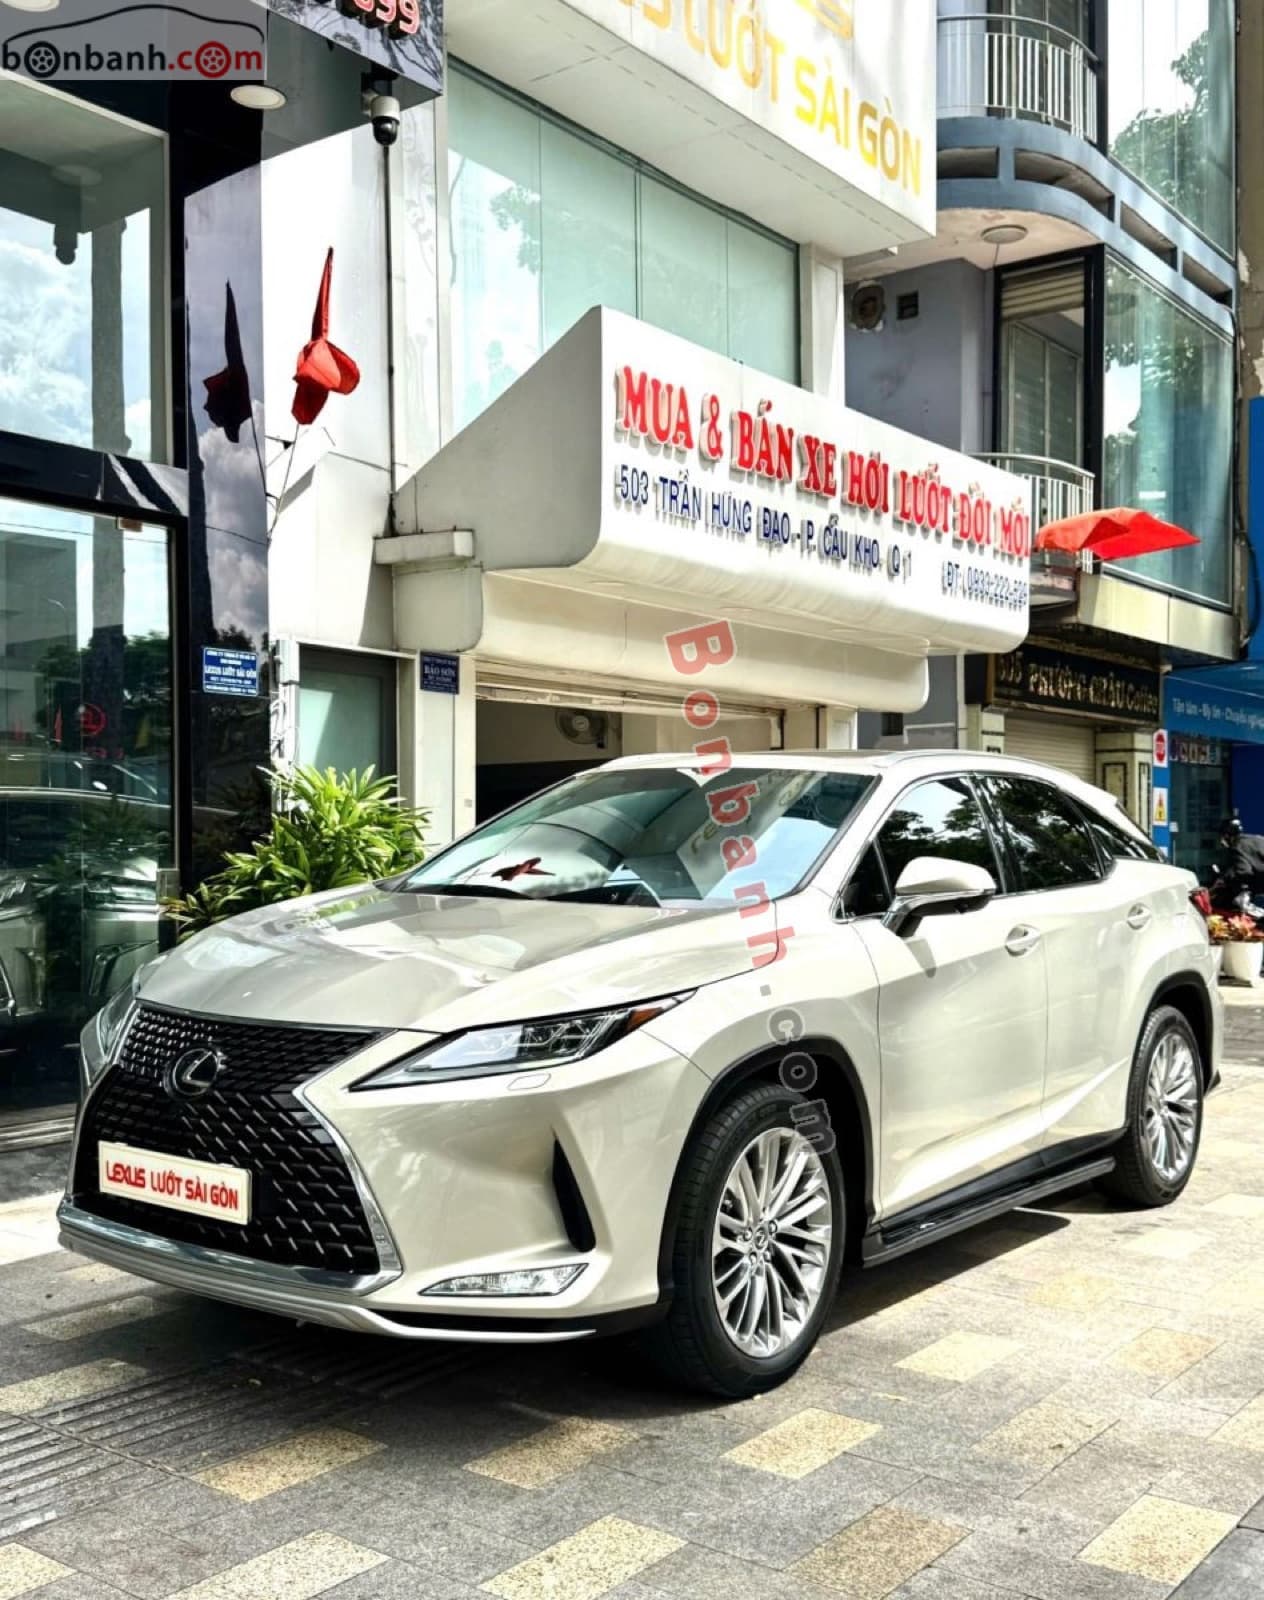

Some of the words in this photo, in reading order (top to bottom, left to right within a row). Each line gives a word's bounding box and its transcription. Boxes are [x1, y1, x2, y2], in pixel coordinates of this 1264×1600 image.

[794, 57, 850, 149] SÀI
[858, 96, 922, 195] GÒN
[614, 366, 694, 450] MUA
[700, 393, 723, 460] &
[732, 399, 795, 482] BÁN
[799, 434, 837, 497] XE
[895, 462, 953, 534] LƯỚT
[998, 497, 1030, 558] MỚI
[617, 464, 649, 505] 503
[657, 469, 702, 521] TRẦN
[820, 513, 849, 560] CẦU
[106, 1160, 146, 1188] LEXUS
[150, 1170, 182, 1196] LƯỚT
[185, 1175, 207, 1203] SÀI
[210, 1182, 238, 1210] GÒN
